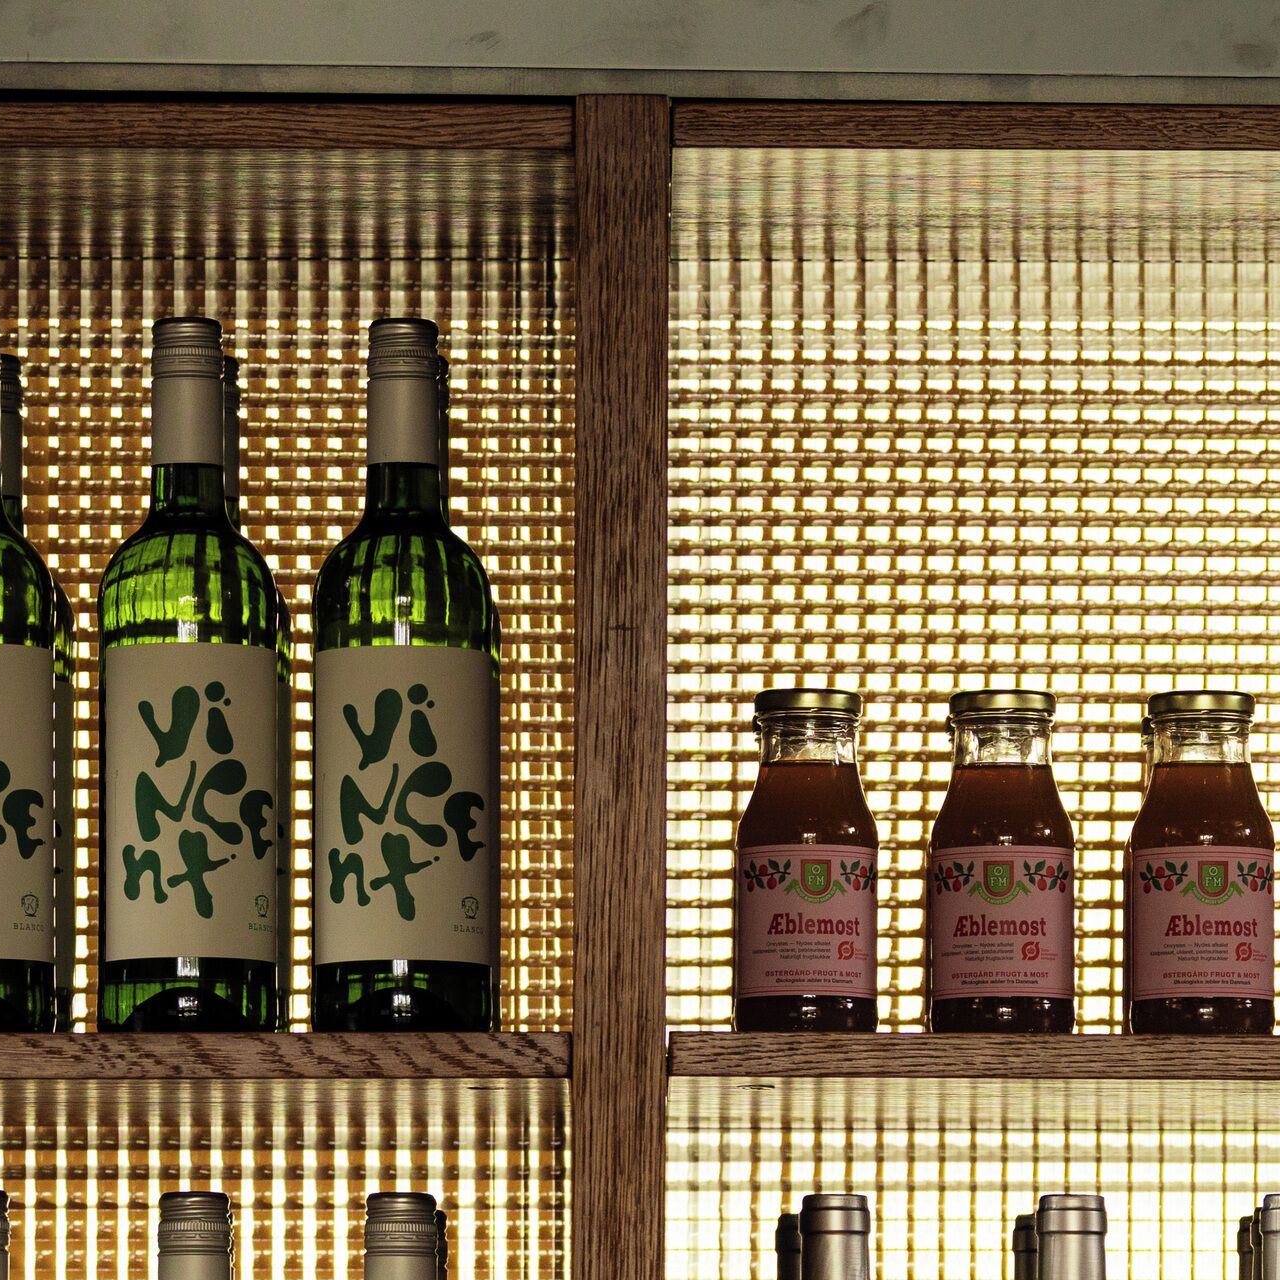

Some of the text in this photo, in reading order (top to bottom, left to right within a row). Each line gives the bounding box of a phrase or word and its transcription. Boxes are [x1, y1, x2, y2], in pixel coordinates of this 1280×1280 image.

[12, 921, 46, 933] BLANCO
[767, 912, 860, 937] Æblemost
[953, 914, 1047, 938] Æblemost
[1165, 914, 1258, 937] Æblemost
[812, 969, 837, 977] FRUGT
[1163, 970, 1209, 979] ØSTERGÅRD
[1243, 972, 1260, 980] MOST
